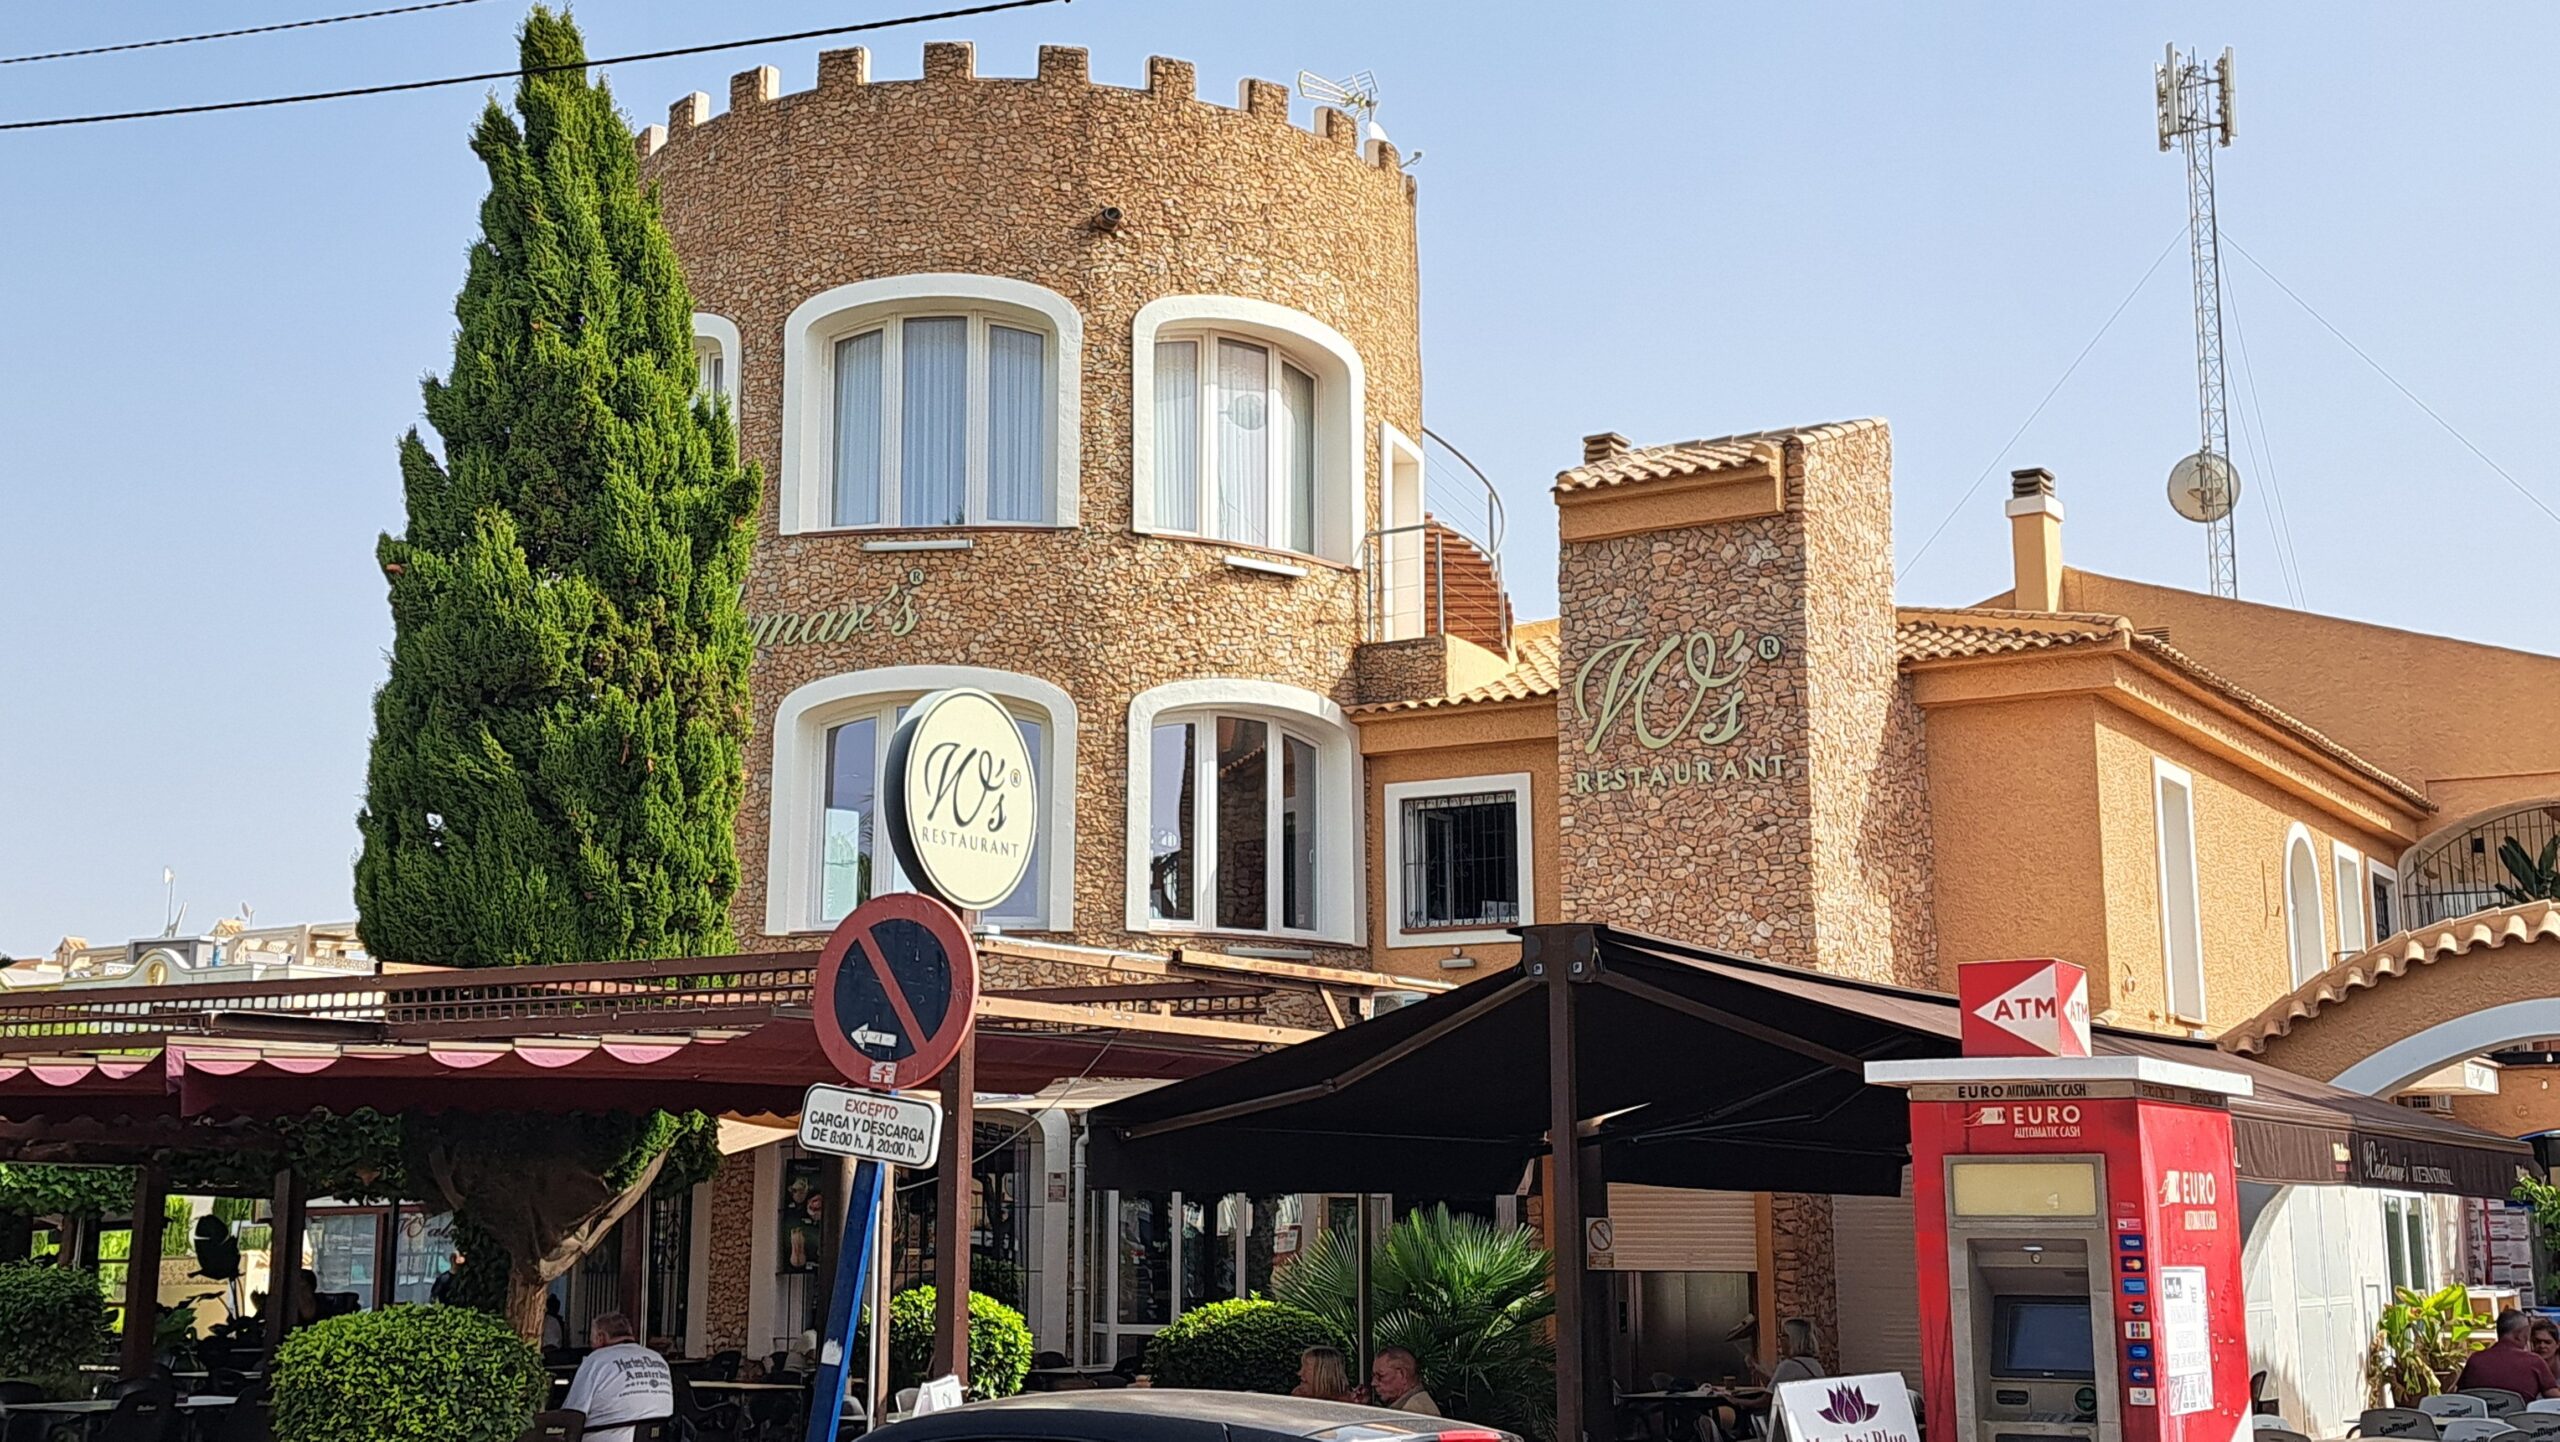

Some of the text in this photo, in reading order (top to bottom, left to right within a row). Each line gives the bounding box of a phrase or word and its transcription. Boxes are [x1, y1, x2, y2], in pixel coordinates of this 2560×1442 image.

[1576, 755, 1786, 794] RESTAURANT
[922, 826, 1019, 858] RESTAURANT
[1994, 997, 2057, 1021] ATM
[2070, 1001, 2090, 1024] ATM
[1958, 1084, 2087, 1098] EURO AUTOMATIC CASH
[844, 1098, 899, 1121] EXCEPTO
[2013, 1106, 2082, 1124] EURO
[810, 1110, 925, 1144] CARGA Y DESCARGA
[2014, 1125, 2081, 1138] AUTOMATIC CASH
[811, 1126, 829, 1142] DE
[830, 1130, 853, 1146] 8:00
[866, 1135, 875, 1151] A
[876, 1138, 906, 1156] 20:00
[2182, 1172, 2216, 1205] EURO
